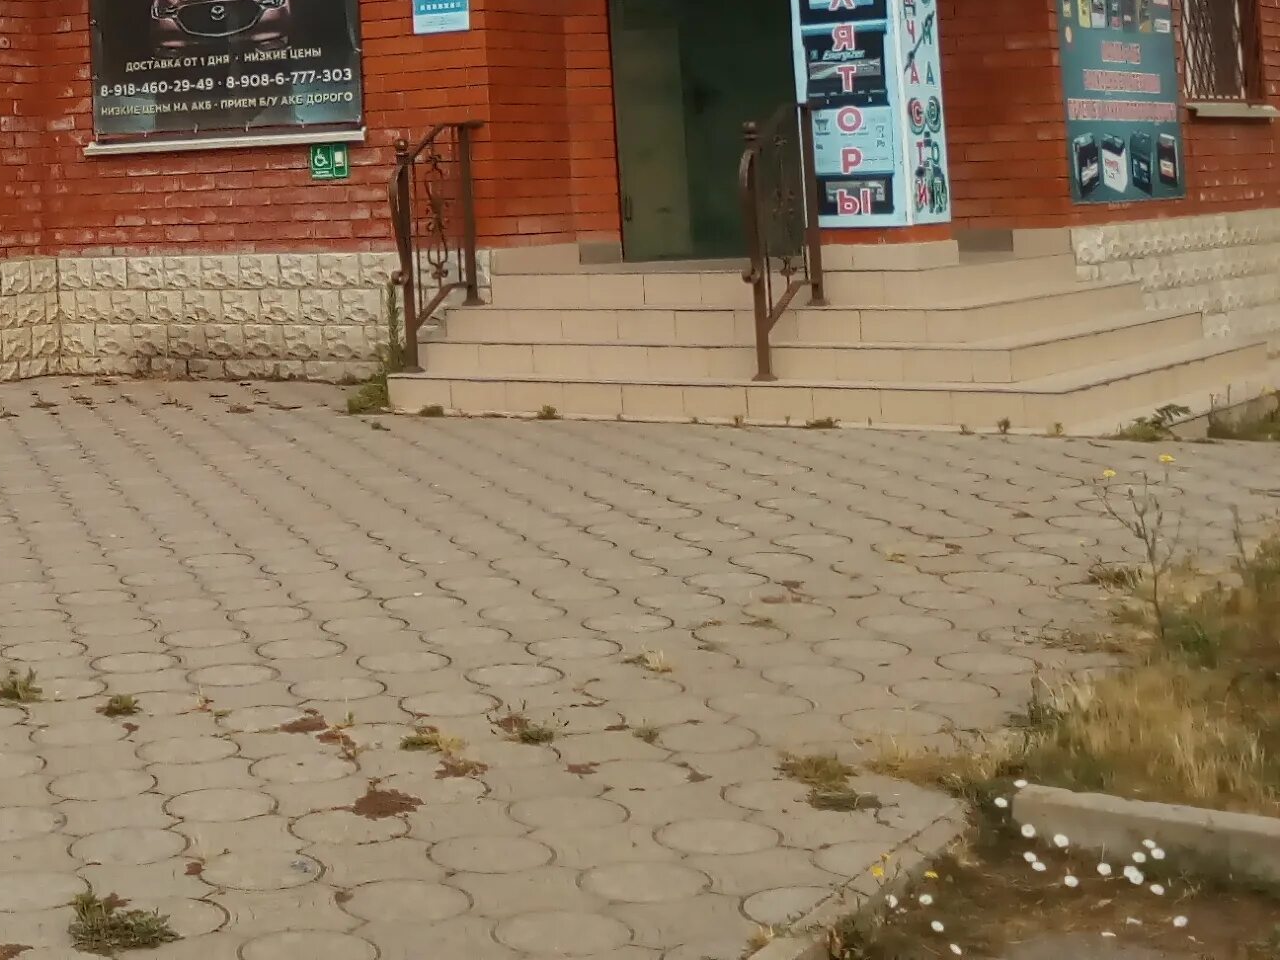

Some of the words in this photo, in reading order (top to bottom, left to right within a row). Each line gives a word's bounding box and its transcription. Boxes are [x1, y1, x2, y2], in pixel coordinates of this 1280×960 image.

[125, 59, 181, 72] ДОСТАВКА
[184, 57, 198, 67] ОТ
[207, 55, 230, 66] ДНЯ
[244, 50, 287, 62] НИЗКИЕ
[290, 48, 321, 59] ЦЕНЫ
[100, 78, 214, 97] 8-918-460-29-49
[226, 68, 352, 88] 8-908-6-777-303
[101, 105, 141, 116] НИЗКИЕ
[142, 103, 171, 114] ЦЕНЫ
[174, 102, 188, 111] НА
[191, 101, 212, 111] АКБ
[220, 98, 257, 109] ПРИЕМ
[259, 97, 278, 107] Б/У
[307, 91, 353, 105] ДОРОГО
